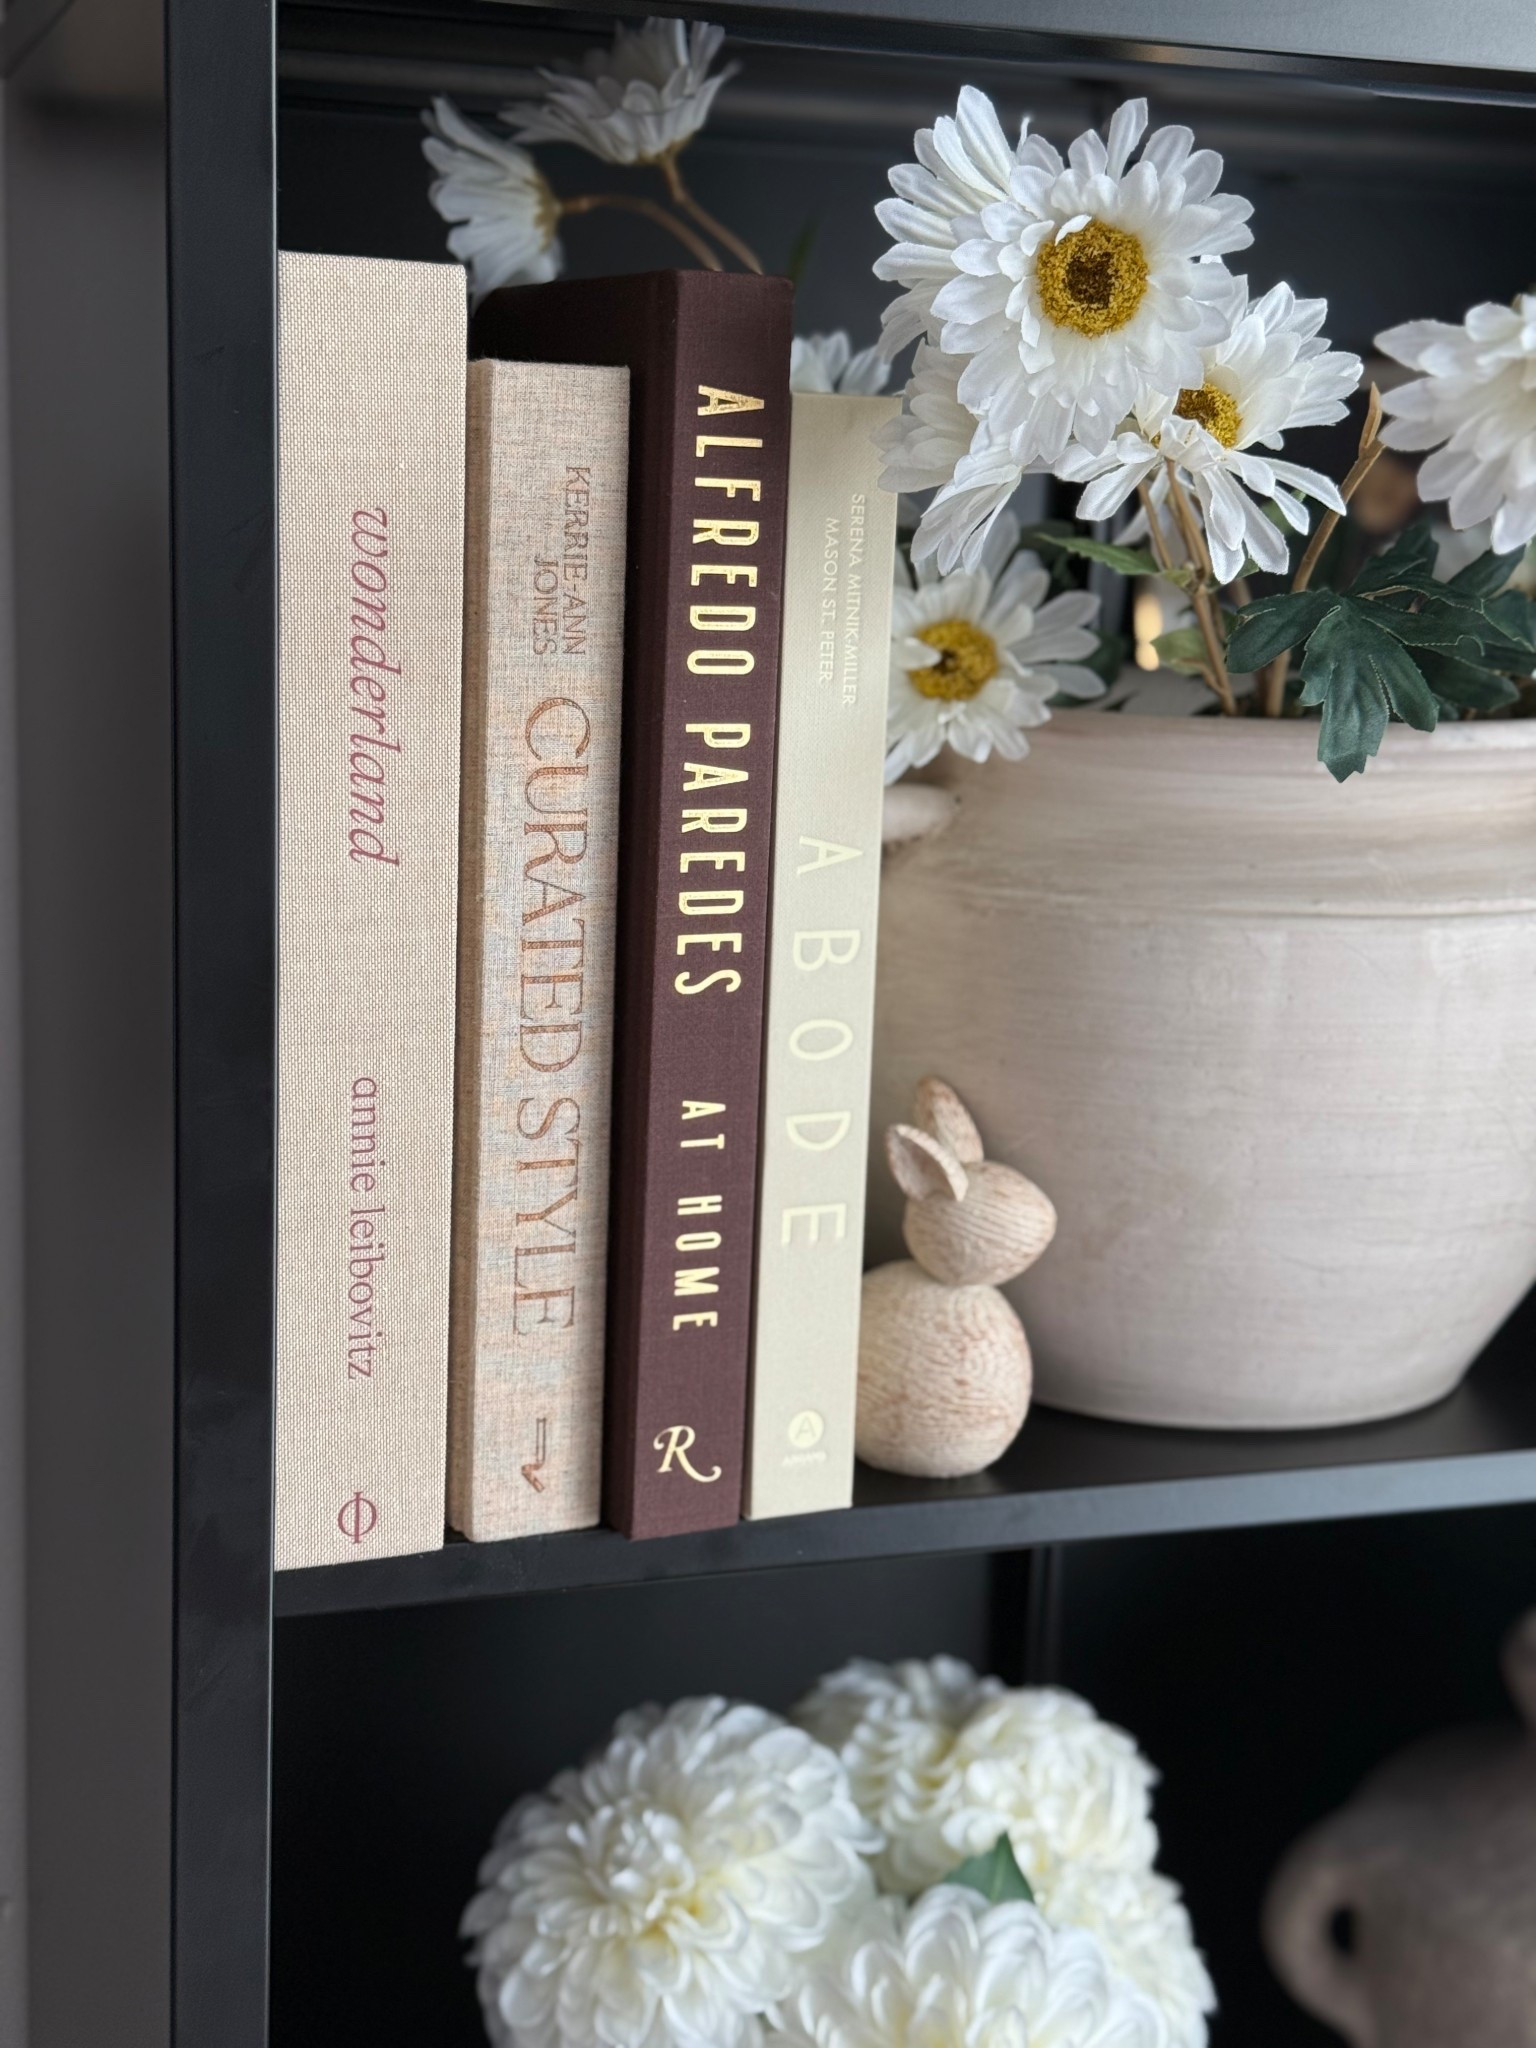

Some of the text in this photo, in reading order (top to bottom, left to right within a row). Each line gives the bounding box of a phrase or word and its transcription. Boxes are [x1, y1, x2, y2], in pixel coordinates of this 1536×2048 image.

[533, 553, 559, 655] JONES
[562, 466, 591, 655] KERRIE-ANN
[818, 517, 840, 684] MASON ST. PETER
[848, 494, 866, 568] SERENA
[349, 508, 401, 866] wonderland
[674, 385, 764, 995] ALFREDO PAREDES
[513, 697, 591, 1336] CURATED STYLE
[781, 836, 863, 1247] ABODE
[348, 1077, 386, 1381] annie leibovitz
[672, 1100, 726, 1331] AT HOME
[653, 1425, 722, 1482] R
